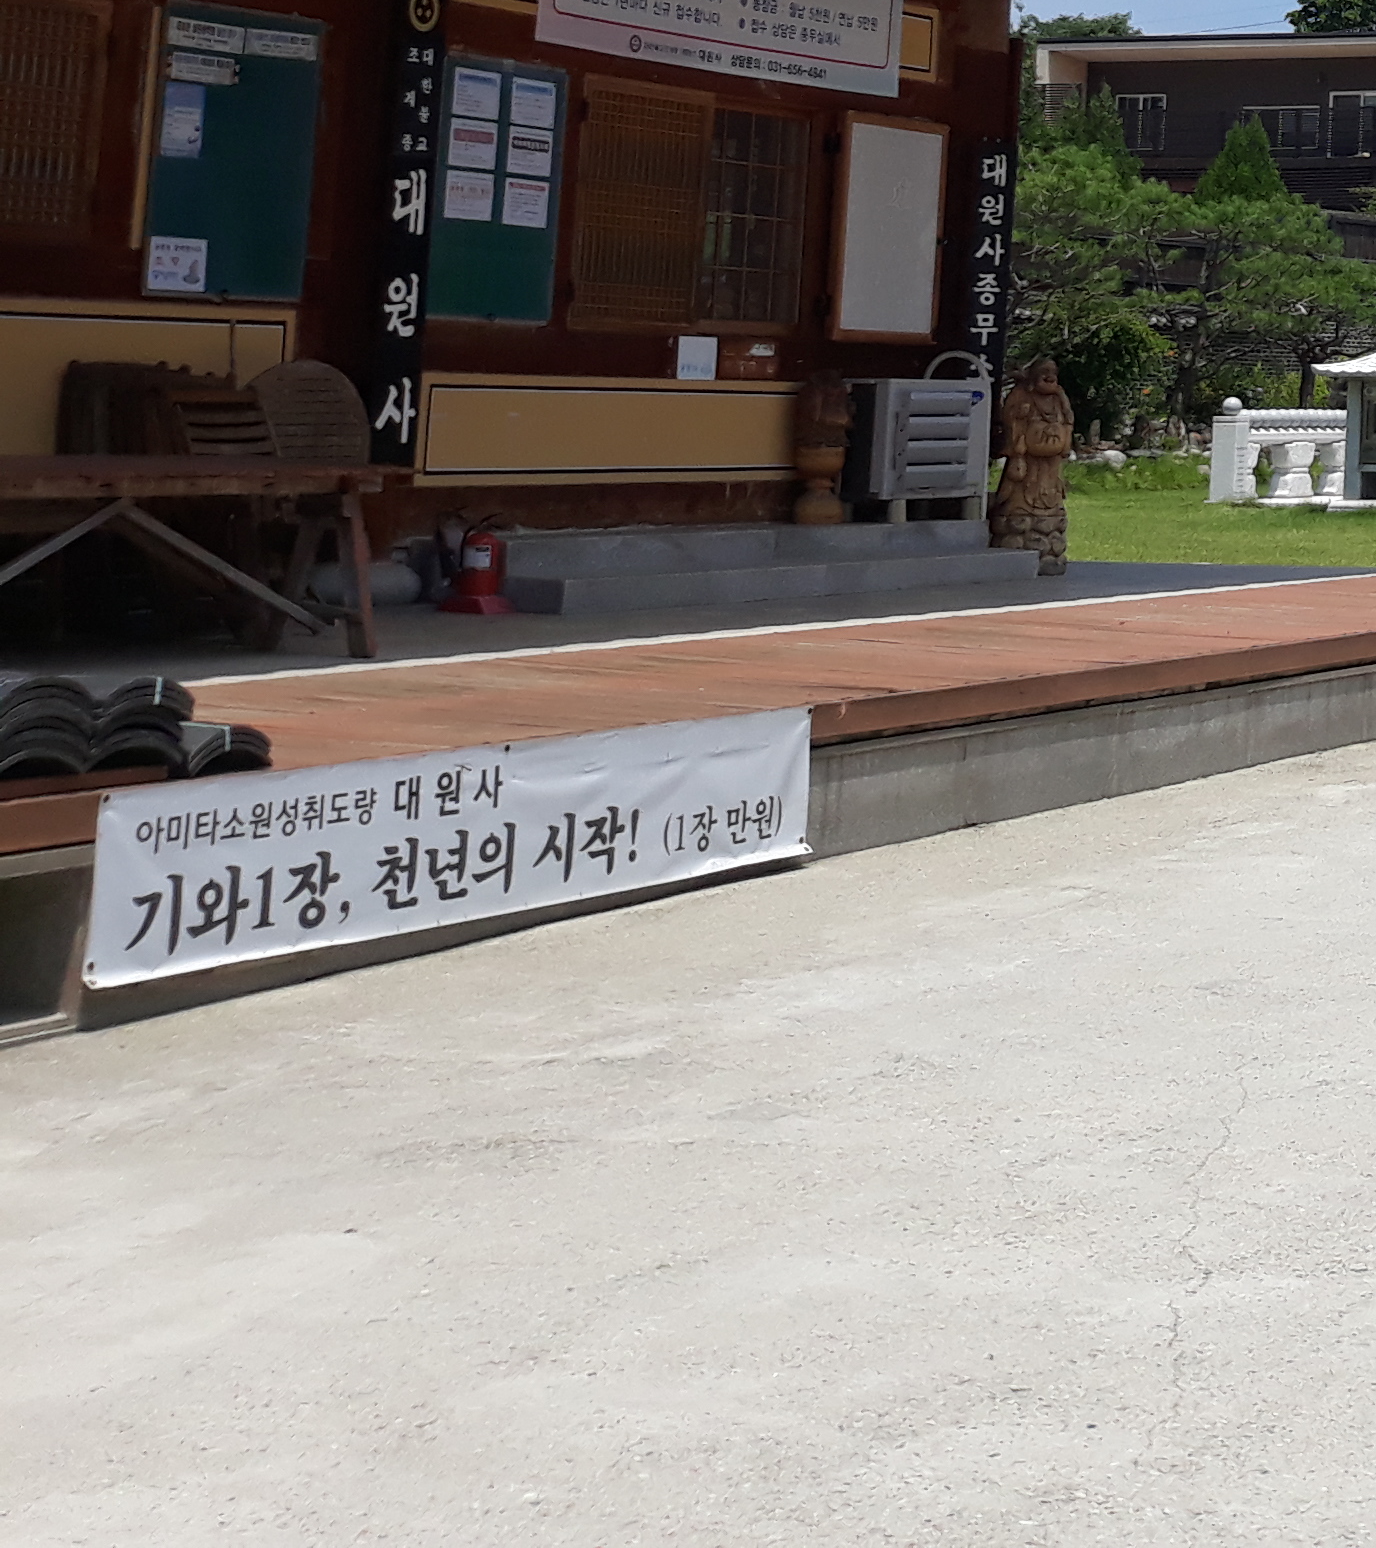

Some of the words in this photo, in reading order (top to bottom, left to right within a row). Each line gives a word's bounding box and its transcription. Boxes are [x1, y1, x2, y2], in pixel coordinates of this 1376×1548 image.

[374, 168, 427, 444] 대원사
[124, 850, 352, 956] 기와1장,
[371, 822, 516, 911] 천년의
[532, 804, 642, 884] 시작!
[663, 804, 717, 857] (1장
[726, 794, 783, 848] 만원)
[135, 785, 377, 855] 아미타소원성취도량
